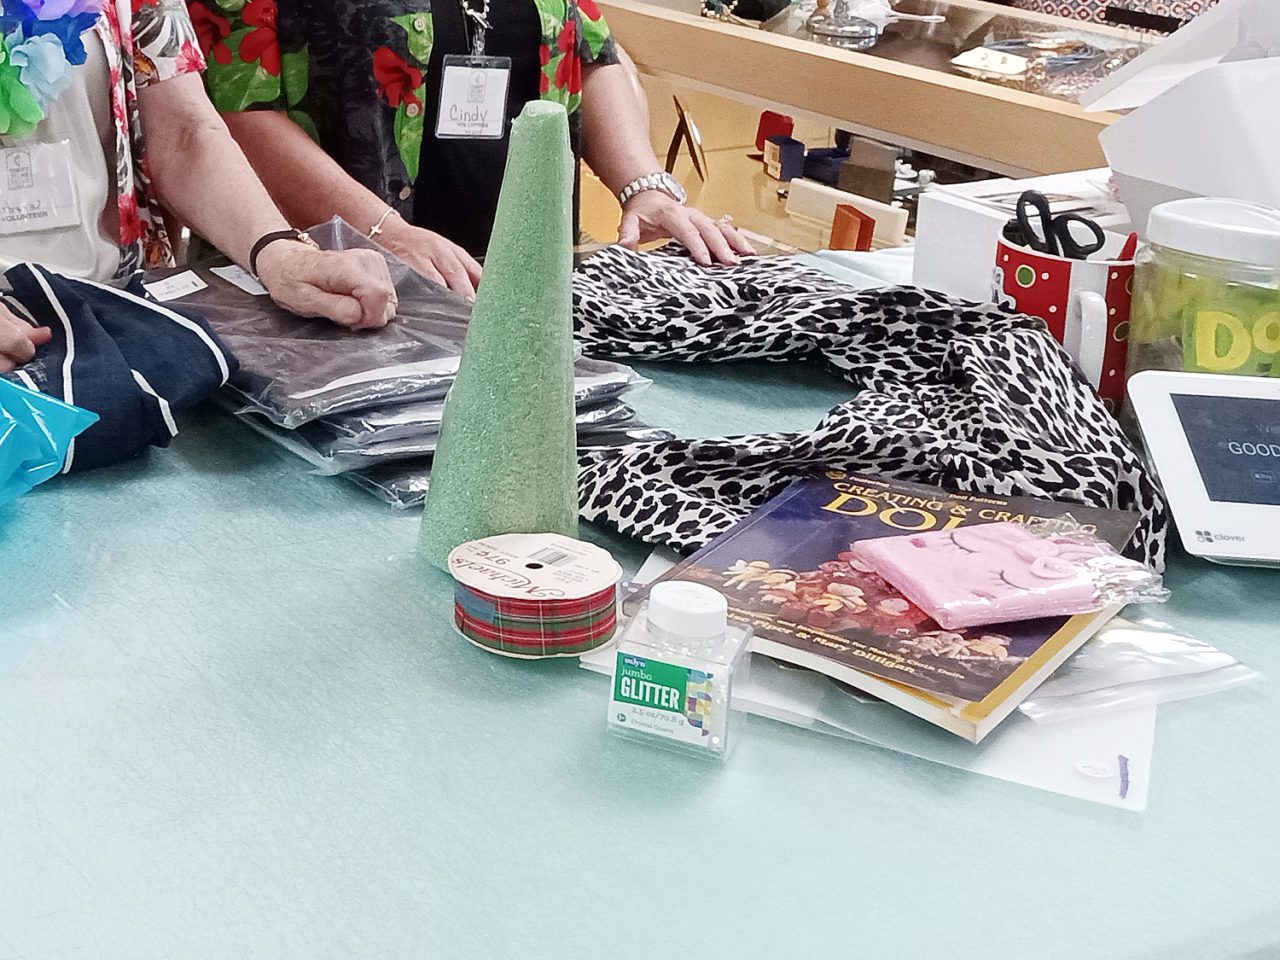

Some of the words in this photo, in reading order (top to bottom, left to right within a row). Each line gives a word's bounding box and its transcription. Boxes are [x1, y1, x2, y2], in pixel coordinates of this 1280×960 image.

[450, 103, 488, 122] Cindy
[1228, 441, 1280, 457] GOOD
[833, 482, 943, 511] CREATING
[452, 557, 566, 598] Michaels
[621, 666, 652, 681] jumbo
[620, 676, 680, 710] GLITTER
